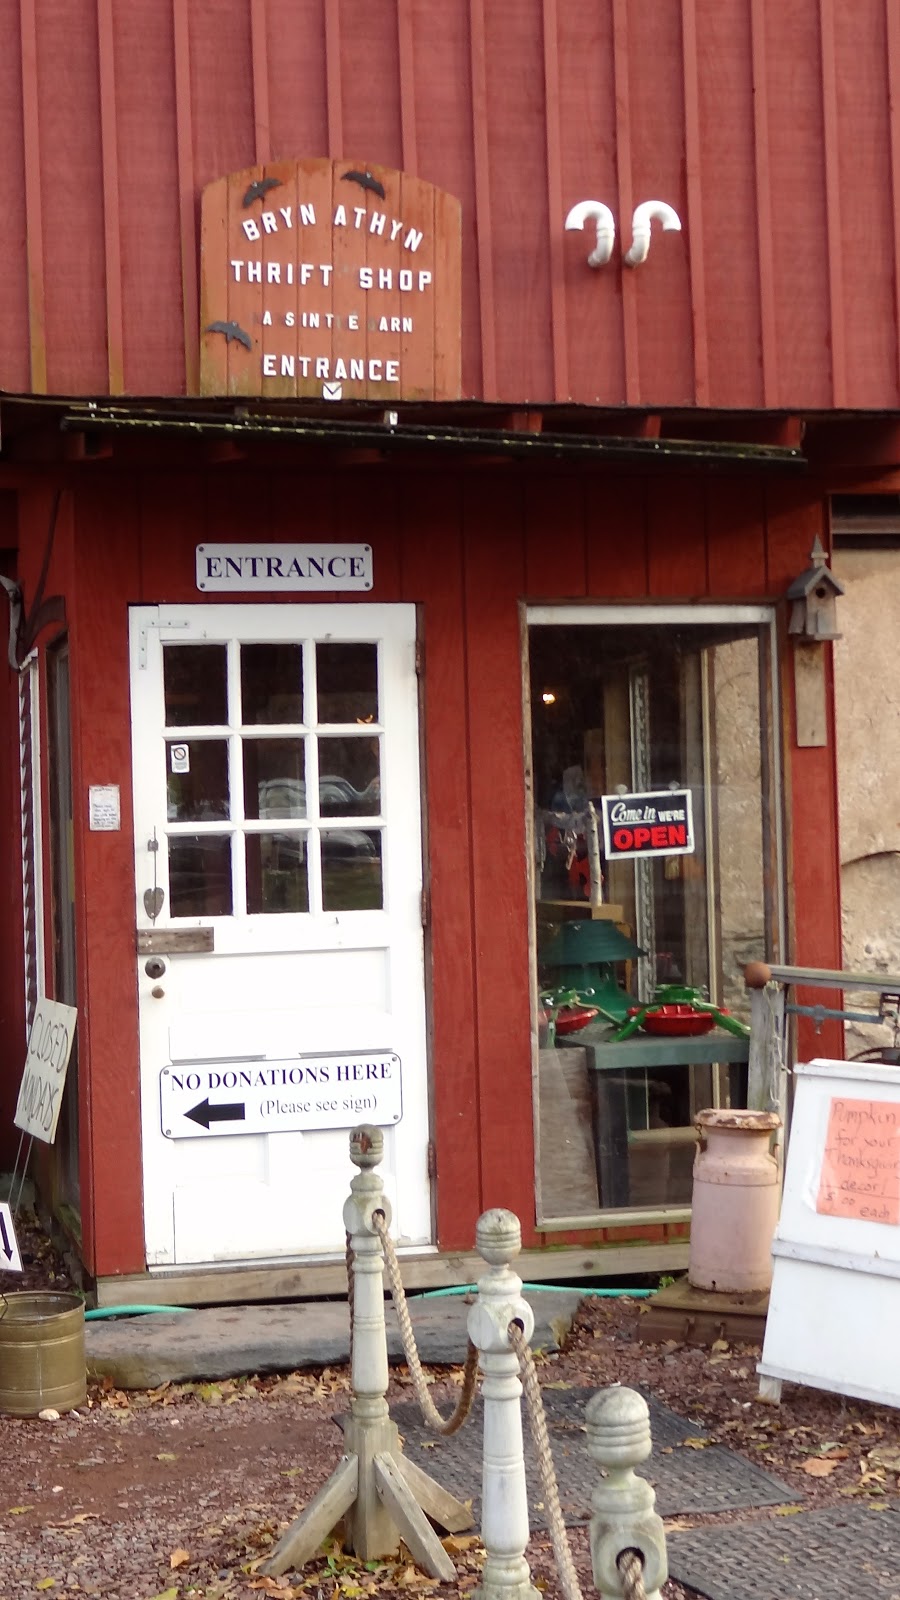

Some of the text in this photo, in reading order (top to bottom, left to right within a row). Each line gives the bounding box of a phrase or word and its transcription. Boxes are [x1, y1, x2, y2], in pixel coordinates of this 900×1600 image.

[242, 203, 423, 252] BRYN ATHYN
[230, 260, 432, 292] THRIFT SHOP
[374, 316, 413, 333] ARN
[263, 354, 400, 382] ENTRANCE
[205, 556, 365, 578] ENTRANCE
[610, 802, 643, 823] Come
[643, 805, 657, 821] in
[613, 824, 686, 851] OPEN
[30, 1012, 69, 1073] CLOSED
[171, 1062, 392, 1091] NO DONATIONS HERE
[259, 1094, 377, 1118] (Please see sign)
[834, 1128, 859, 1147] for
[859, 1203, 890, 1219] each
